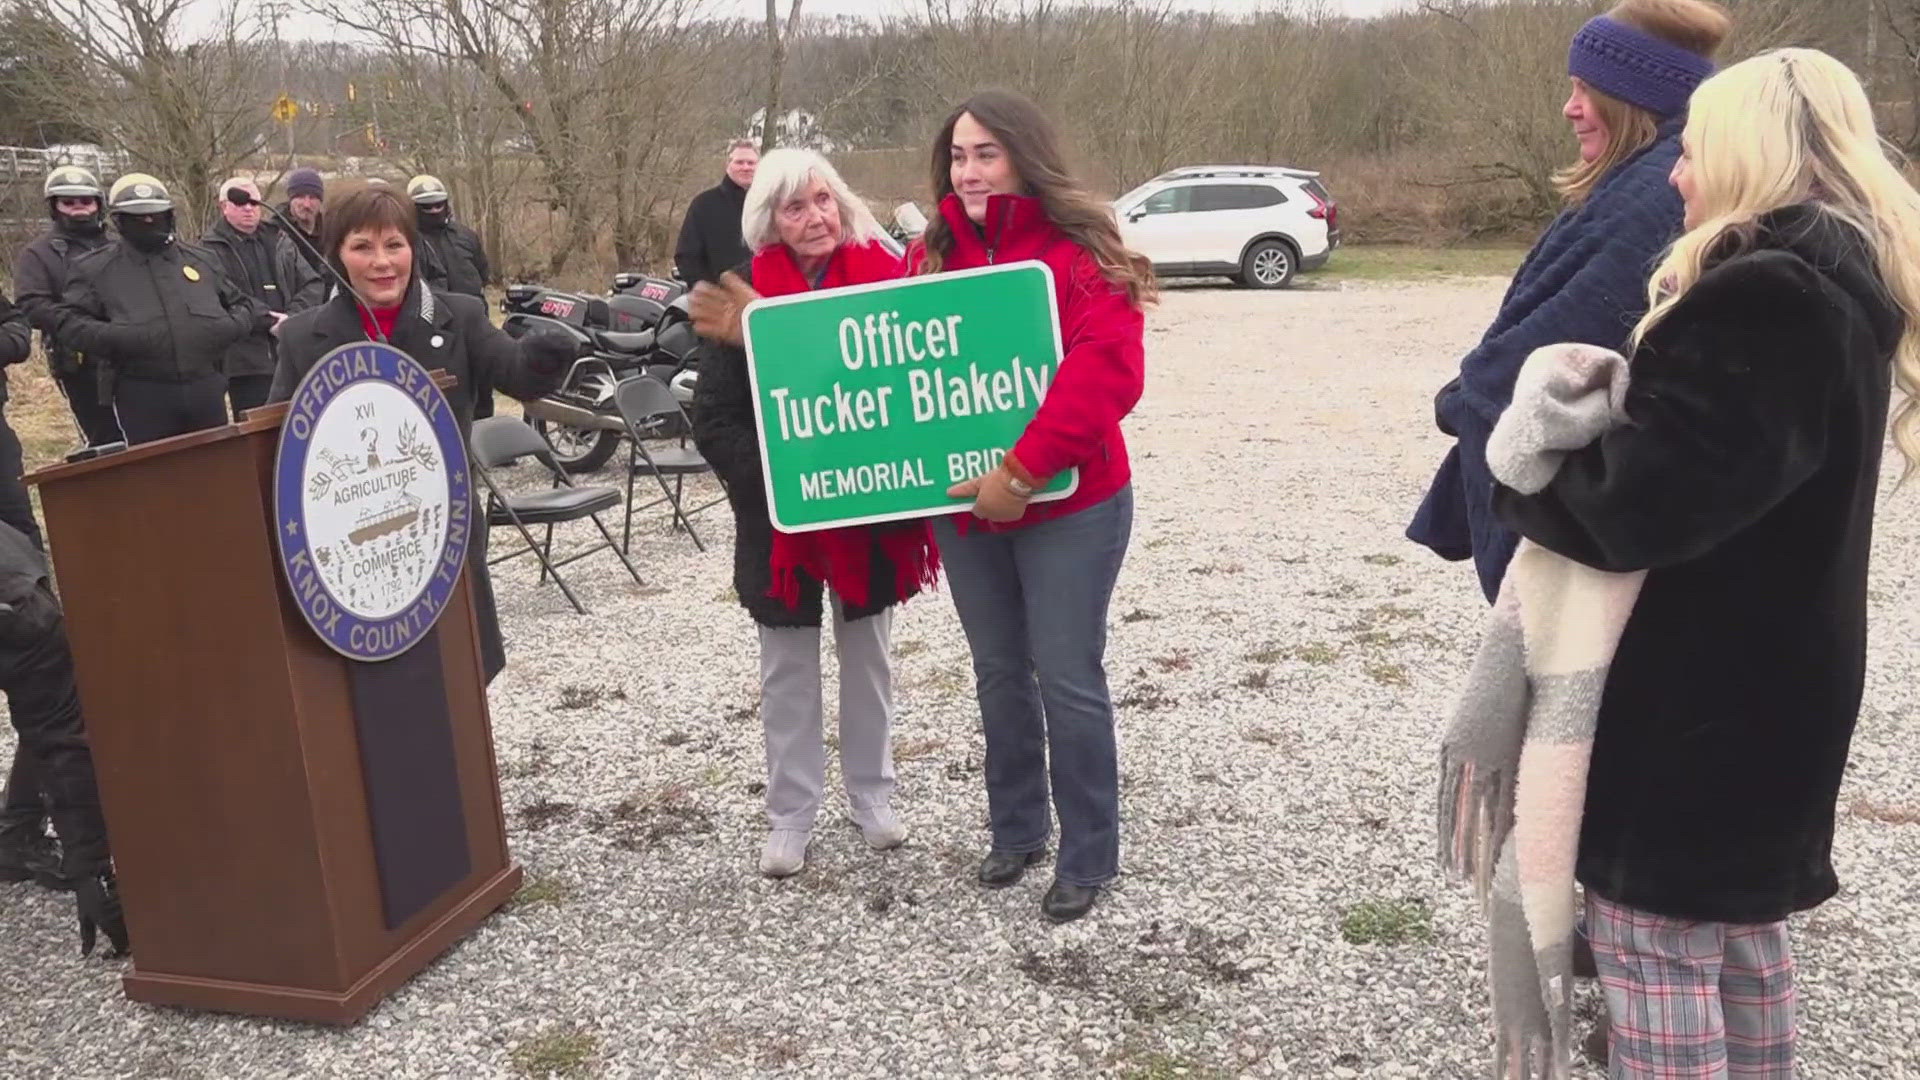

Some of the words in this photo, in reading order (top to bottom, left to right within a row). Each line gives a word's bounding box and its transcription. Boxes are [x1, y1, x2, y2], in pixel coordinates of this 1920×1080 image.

[838, 310, 963, 371] Officer
[291, 348, 382, 441] OFFICIAL
[395, 359, 440, 423] SEAL
[354, 401, 375, 421] XVI
[770, 381, 893, 441] Tucker
[908, 356, 1049, 423] Blakely
[333, 467, 418, 507] AGRICULTURE
[799, 457, 934, 502] MEMORIAL
[947, 447, 1006, 483] BRID
[290, 548, 340, 638] KNOX
[350, 594, 442, 652] COUNTY,
[437, 491, 467, 584] TENN.
[353, 539, 422, 579] COMMERCE
[381, 577, 403, 597] 1792
